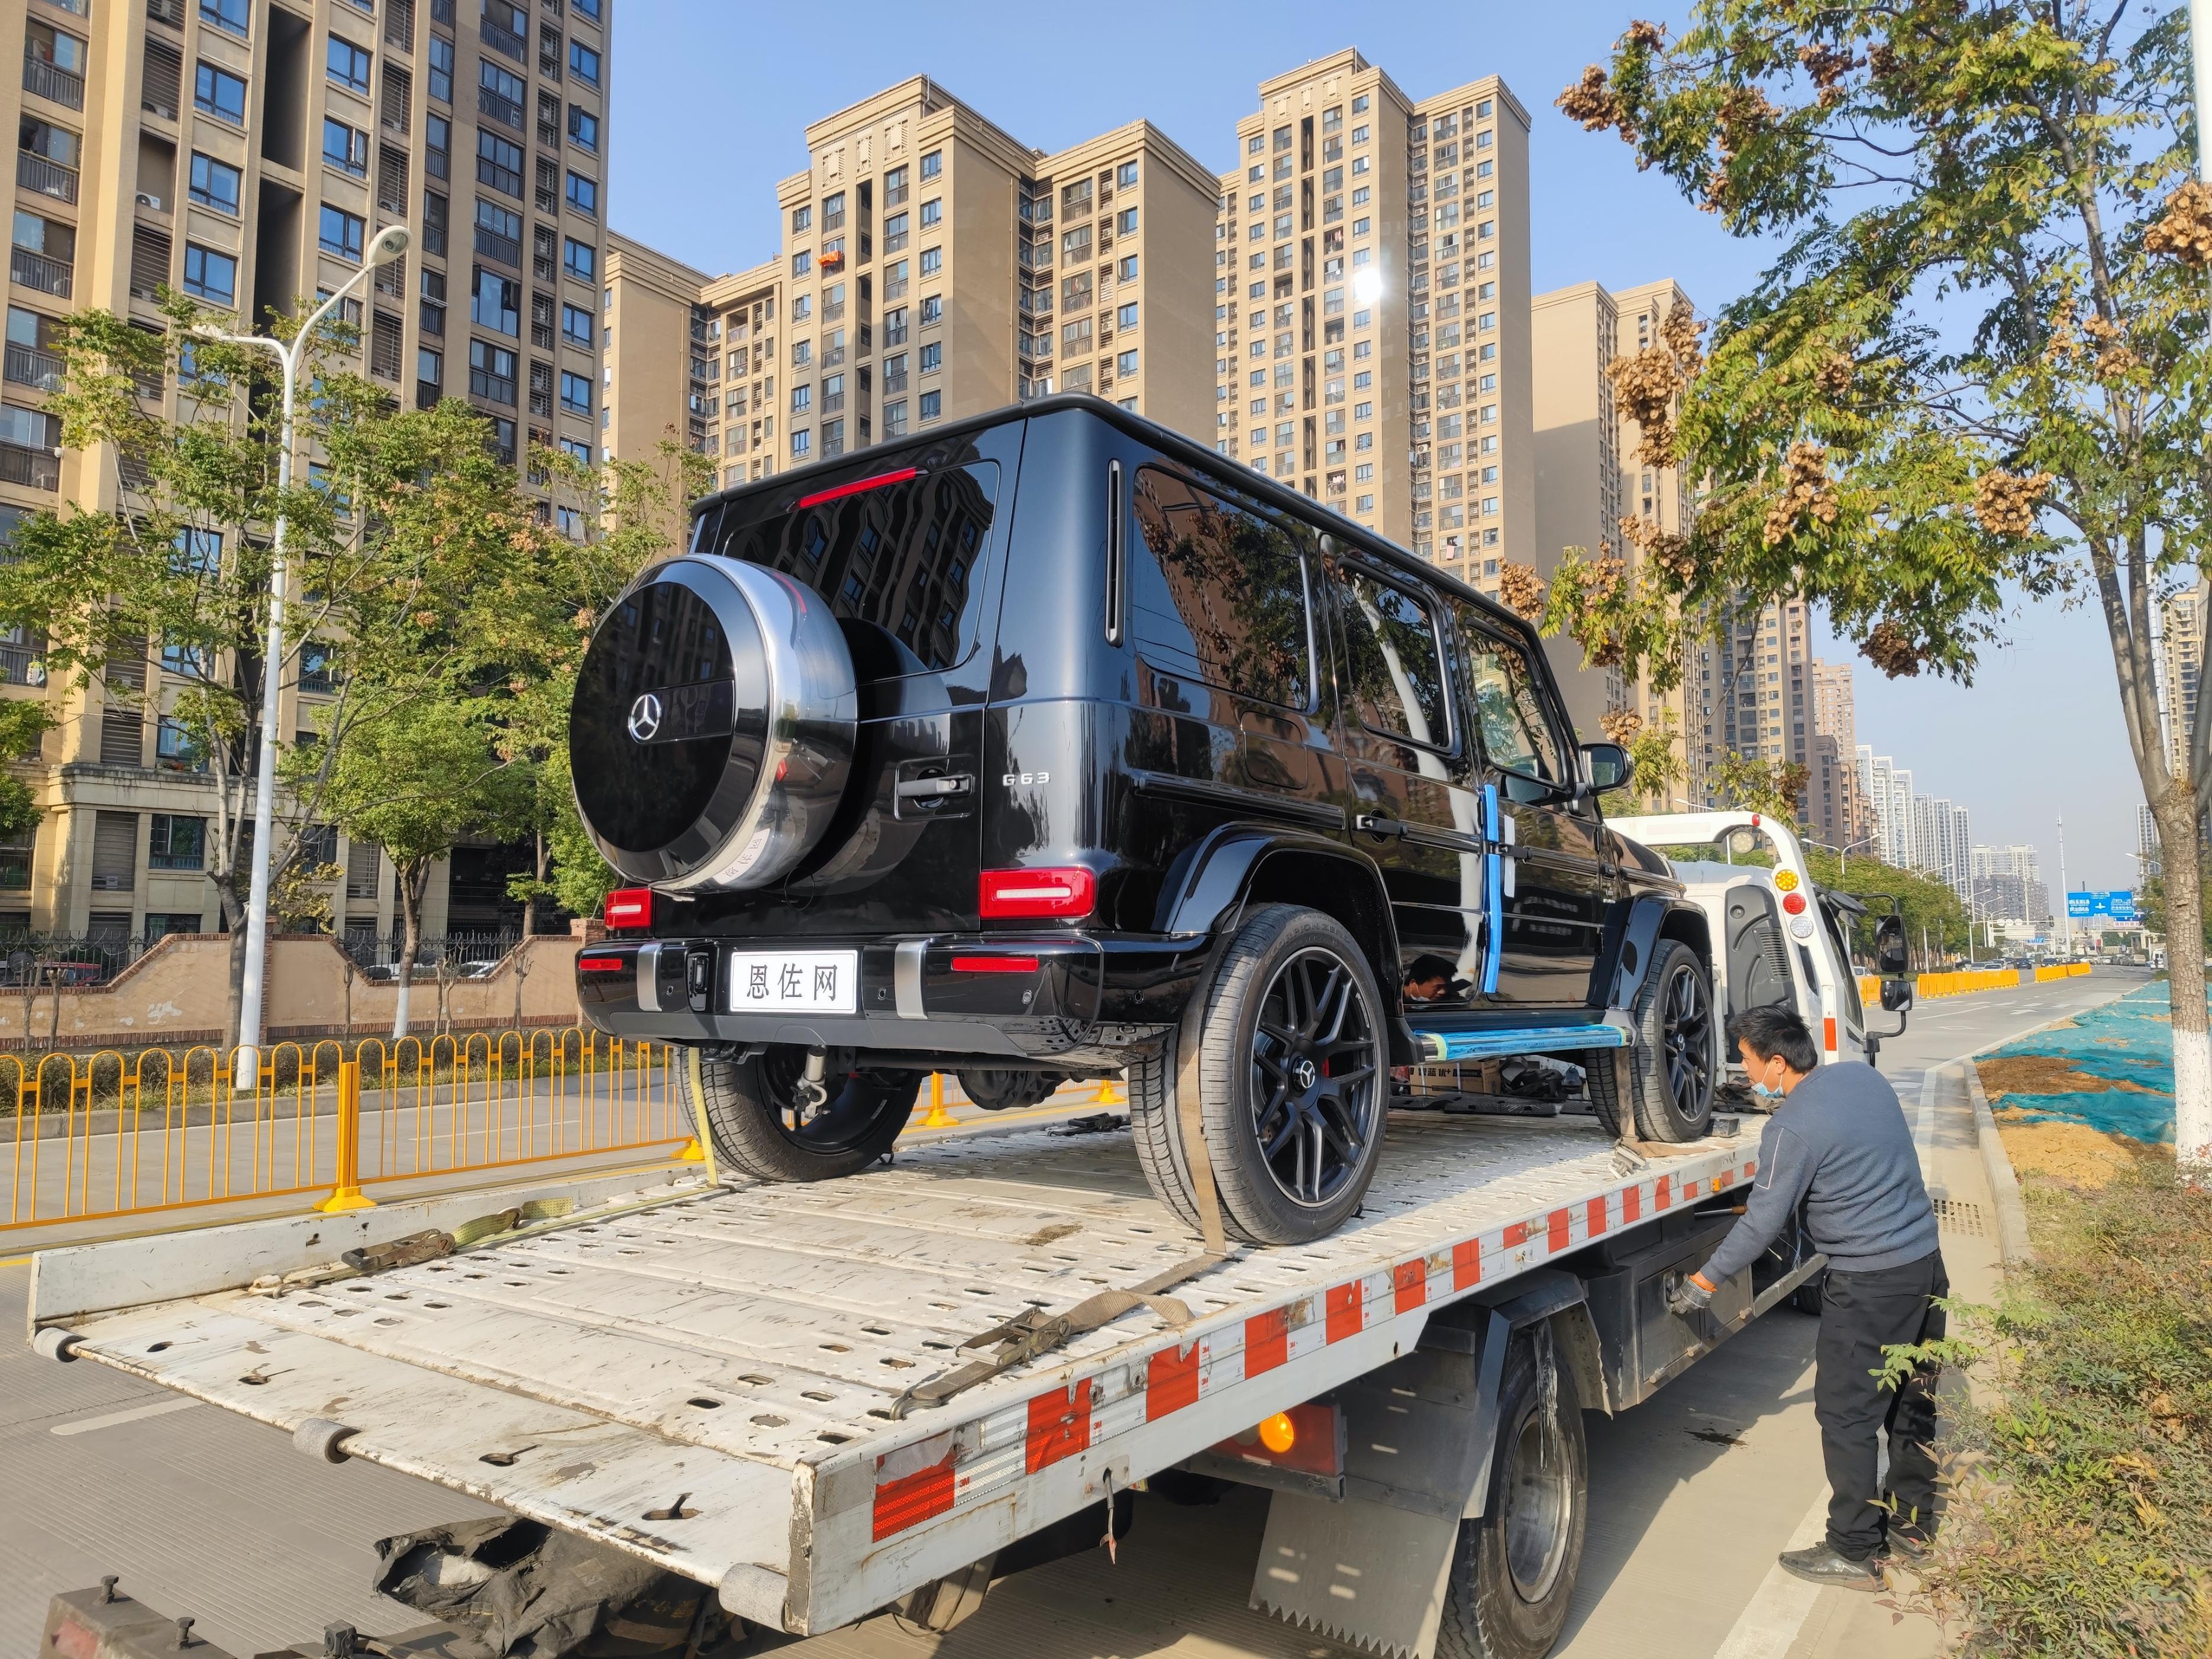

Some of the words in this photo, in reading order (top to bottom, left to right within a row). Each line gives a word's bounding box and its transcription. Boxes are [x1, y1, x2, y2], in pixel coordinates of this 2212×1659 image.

[747, 963, 838, 1001] 恩佐网
[1202, 1345, 1209, 1354] 3M
[1201, 1377, 1209, 1385] 3M
[1093, 1420, 1102, 1430] 3M
[959, 1477, 970, 1487] 3M
